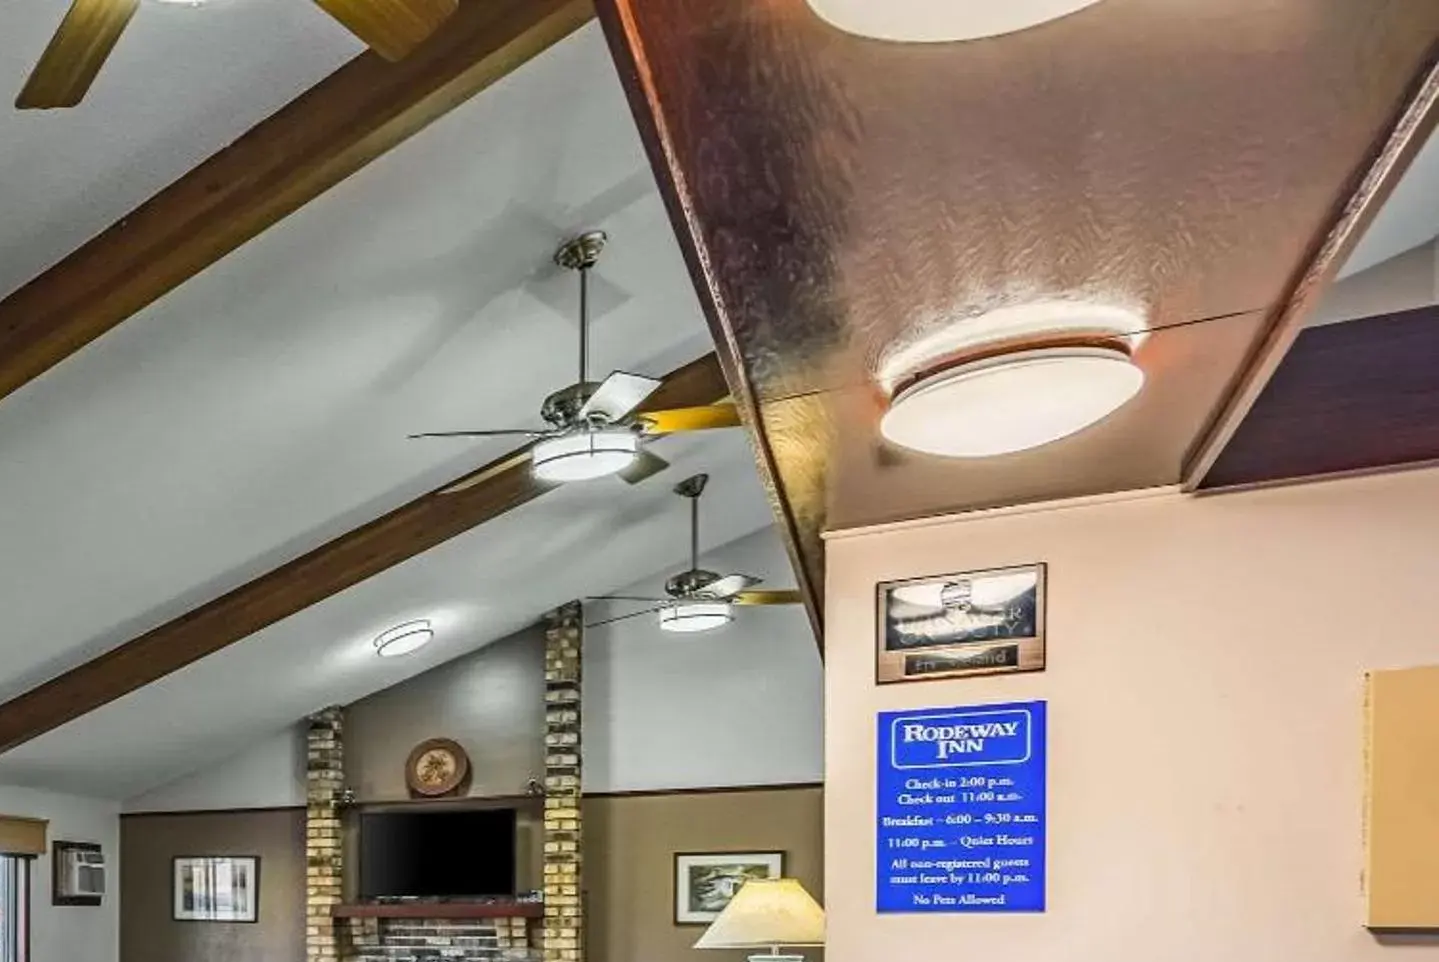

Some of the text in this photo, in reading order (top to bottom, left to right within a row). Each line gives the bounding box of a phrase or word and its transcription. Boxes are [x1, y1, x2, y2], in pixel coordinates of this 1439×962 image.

[903, 721, 1020, 742] RODEWAY
[936, 738, 985, 759] INN
[960, 777, 985, 788] 2:00
[897, 793, 933, 805] Check
[935, 794, 956, 803] out
[962, 792, 994, 802] 11:00
[883, 815, 934, 827] Breakfast
[945, 814, 972, 825] 6:00
[984, 813, 1011, 824] 9:30
[888, 838, 920, 848] 11:00
[960, 836, 994, 848] Quiet
[996, 834, 1034, 846] Hours
[892, 859, 908, 869] All
[993, 858, 1030, 870] guests
[889, 875, 917, 885] must
[920, 873, 948, 885] leave
[950, 873, 964, 886] by
[967, 873, 1001, 883] 11:00
[913, 893, 1006, 905] No Pets Allowed
